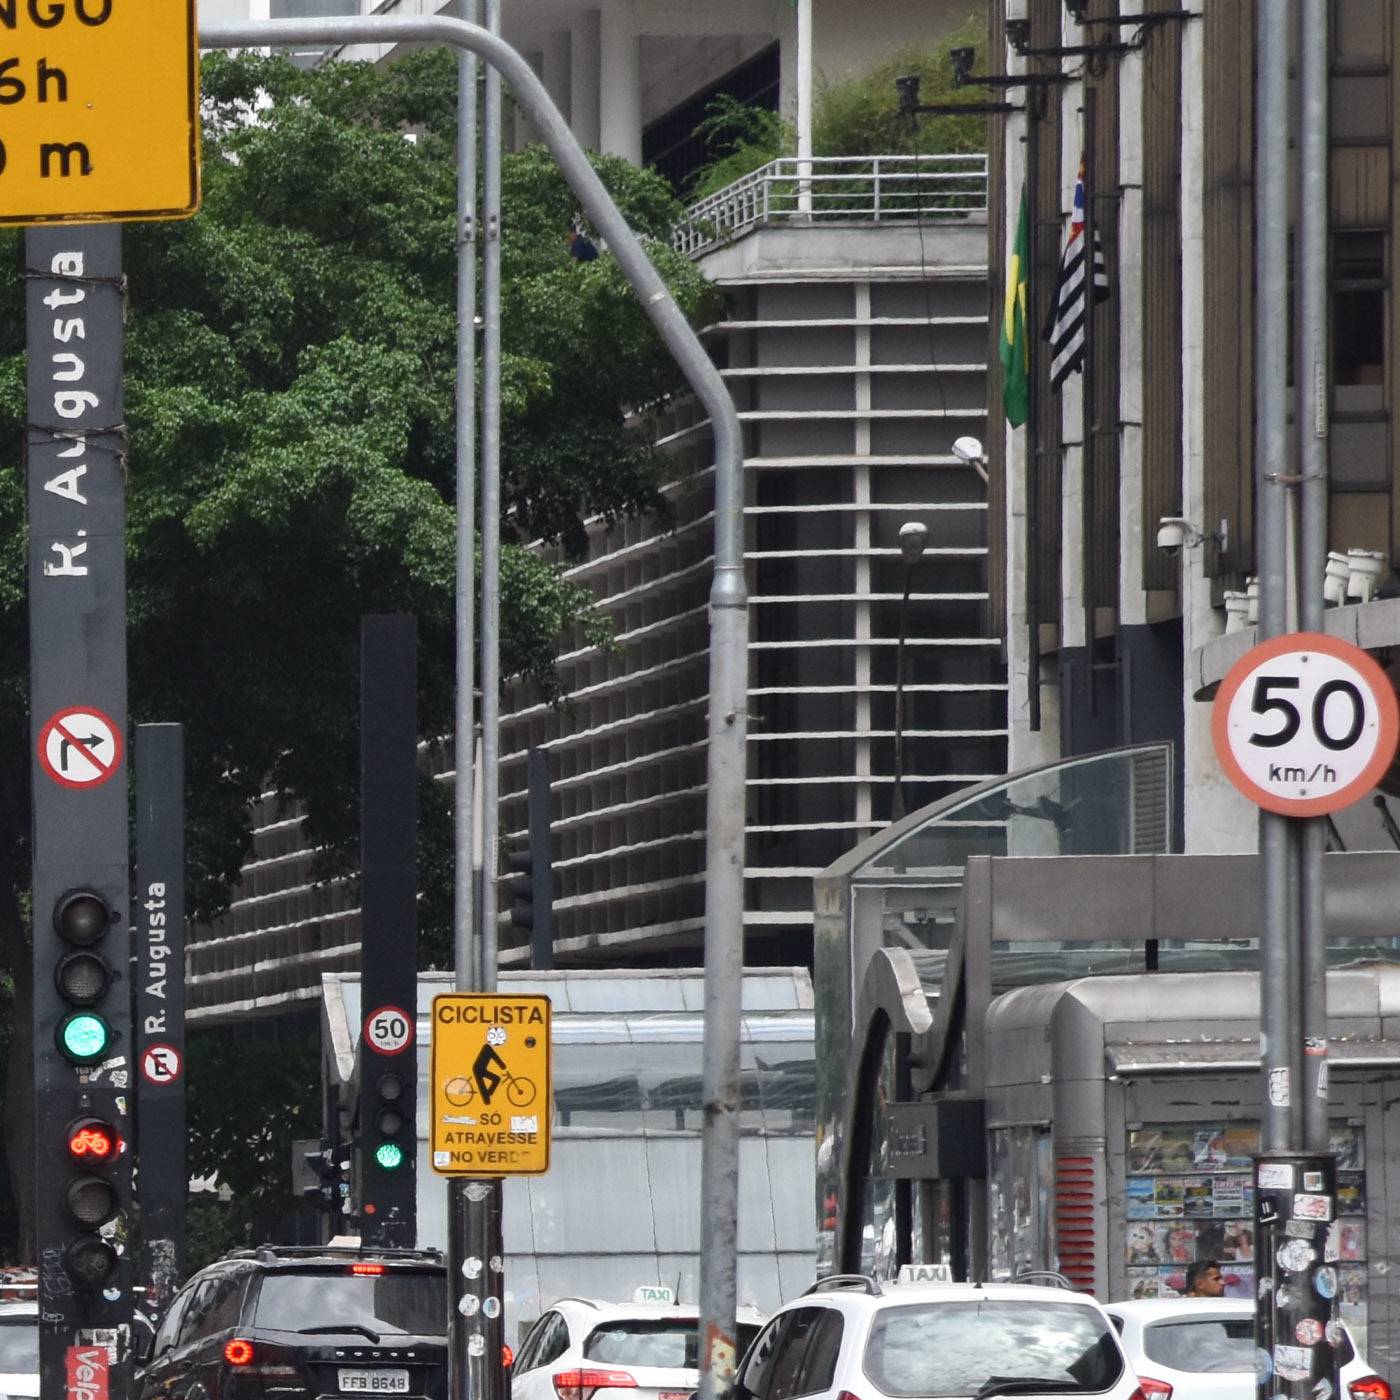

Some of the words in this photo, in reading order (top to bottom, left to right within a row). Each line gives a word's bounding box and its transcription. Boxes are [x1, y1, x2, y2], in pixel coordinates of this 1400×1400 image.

[39, 141, 92, 179] m
[43, 250, 100, 506] Augusta
[1247, 676, 1366, 752] 50
[1268, 763, 1337, 783] km/h
[143, 881, 172, 999] Augusta
[143, 1009, 167, 1034] R.
[437, 1005, 544, 1026] CICLISTA
[374, 1018, 406, 1040] 50
[479, 1110, 502, 1126] SÓ
[444, 1132, 538, 1146] ATRAVESSE
[450, 1151, 473, 1163] NO
[907, 1267, 947, 1282] TAXI
[640, 1288, 671, 1301] TAXI
